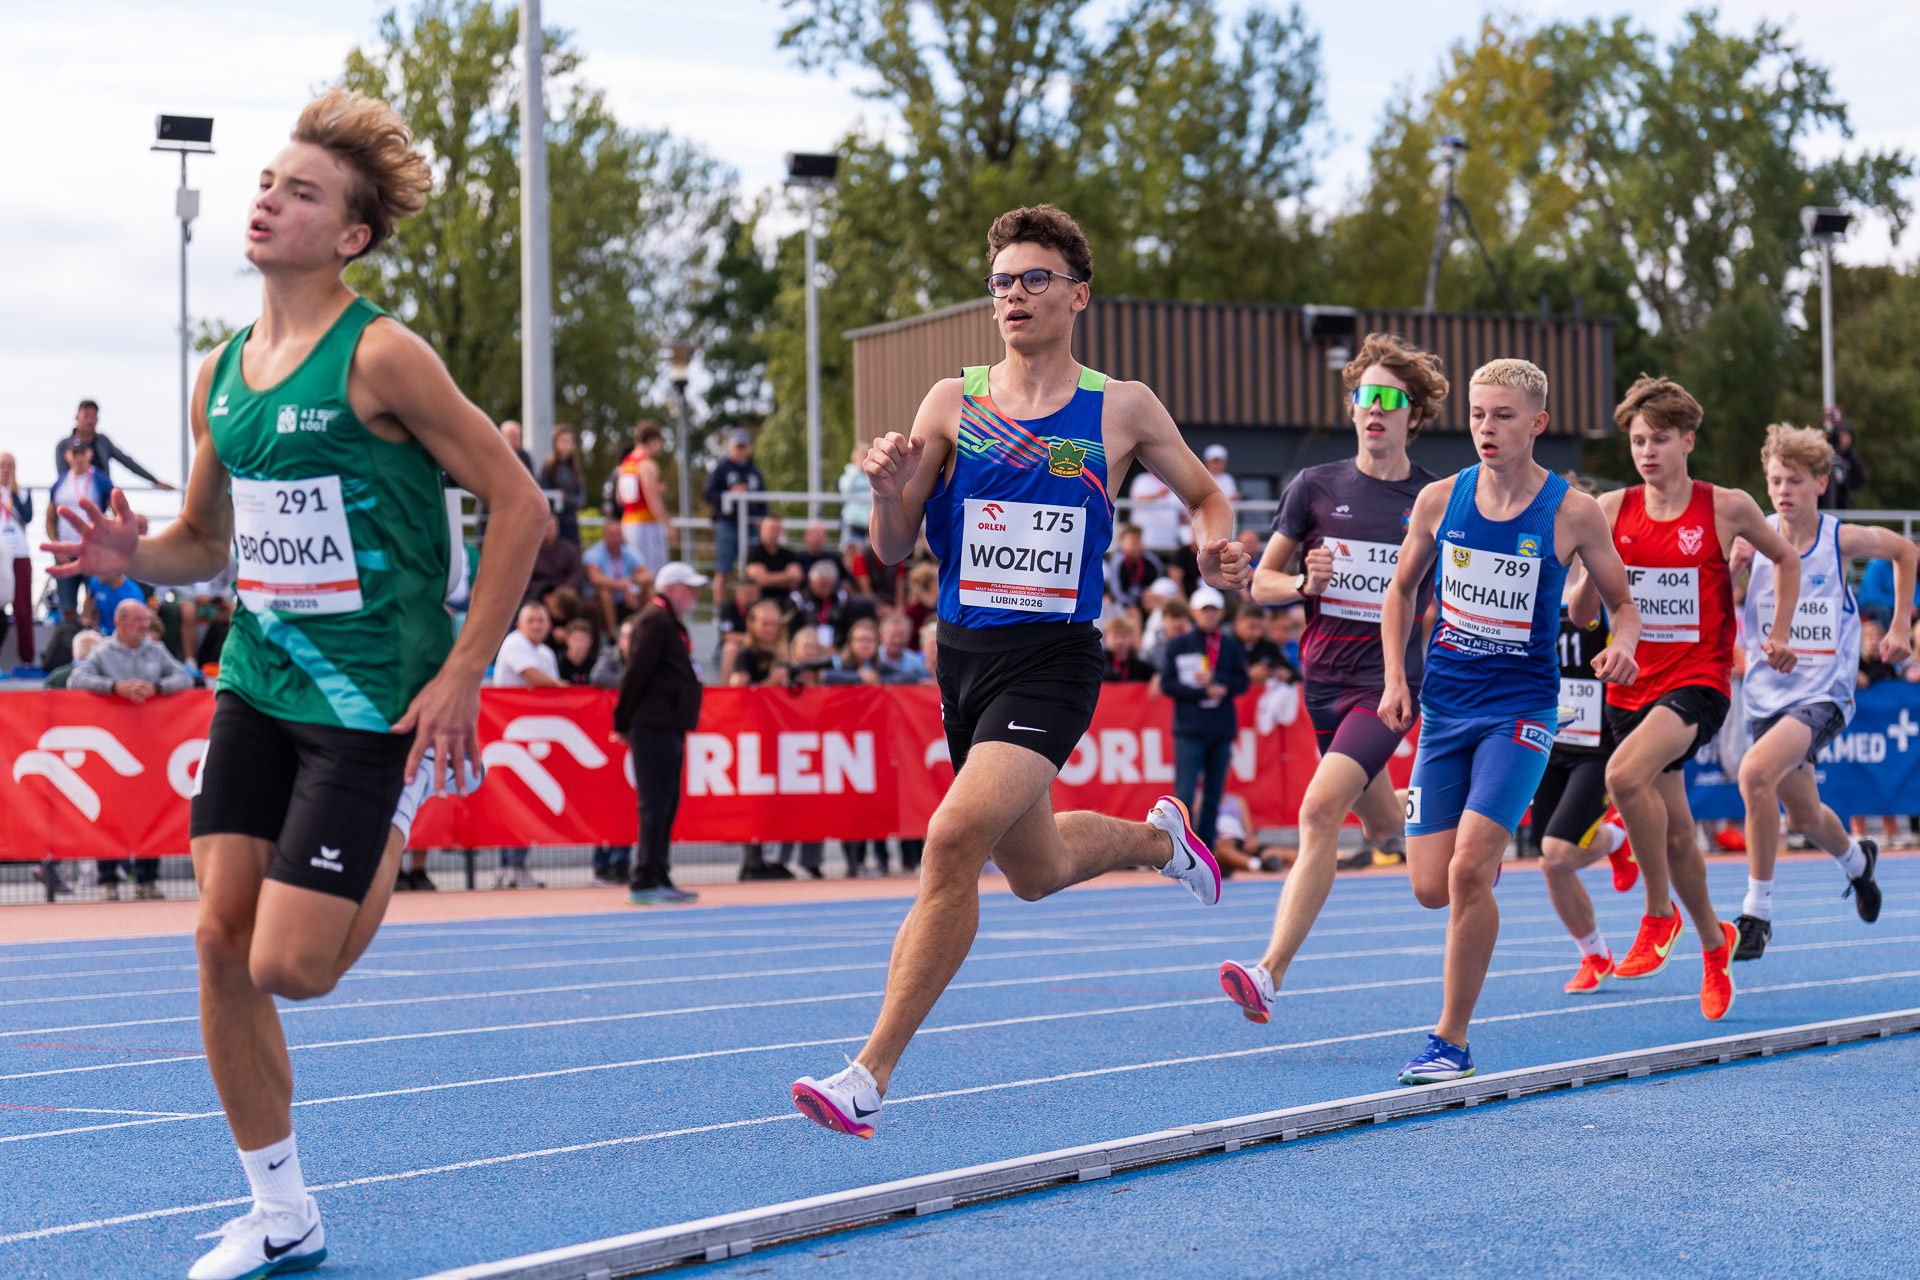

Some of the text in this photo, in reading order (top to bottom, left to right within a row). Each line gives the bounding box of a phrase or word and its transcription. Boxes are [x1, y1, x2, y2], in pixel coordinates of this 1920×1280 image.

[276, 487, 328, 514] 291
[978, 522, 1006, 531] ORLEN
[1033, 510, 1074, 533] 175
[240, 530, 344, 565] BRÓDKA
[1367, 548, 1399, 565] 116
[969, 543, 1073, 575] WOZICH
[1493, 558, 1531, 578] 789
[1657, 572, 1690, 587] 404
[991, 595, 1043, 608] LUBIN 2026
[1445, 575, 1530, 611] MICHALIK
[293, 599, 319, 608] 2026
[1341, 608, 1381, 619] LUBIN 2026
[1799, 602, 1828, 615] 486
[1458, 619, 1501, 636] LUBIN 2026
[1559, 632, 1582, 667] 11
[1568, 685, 1594, 698] 130
[1056, 727, 1256, 785] ORLN
[1817, 733, 1887, 763] XMED
[623, 731, 877, 796] RLEN
